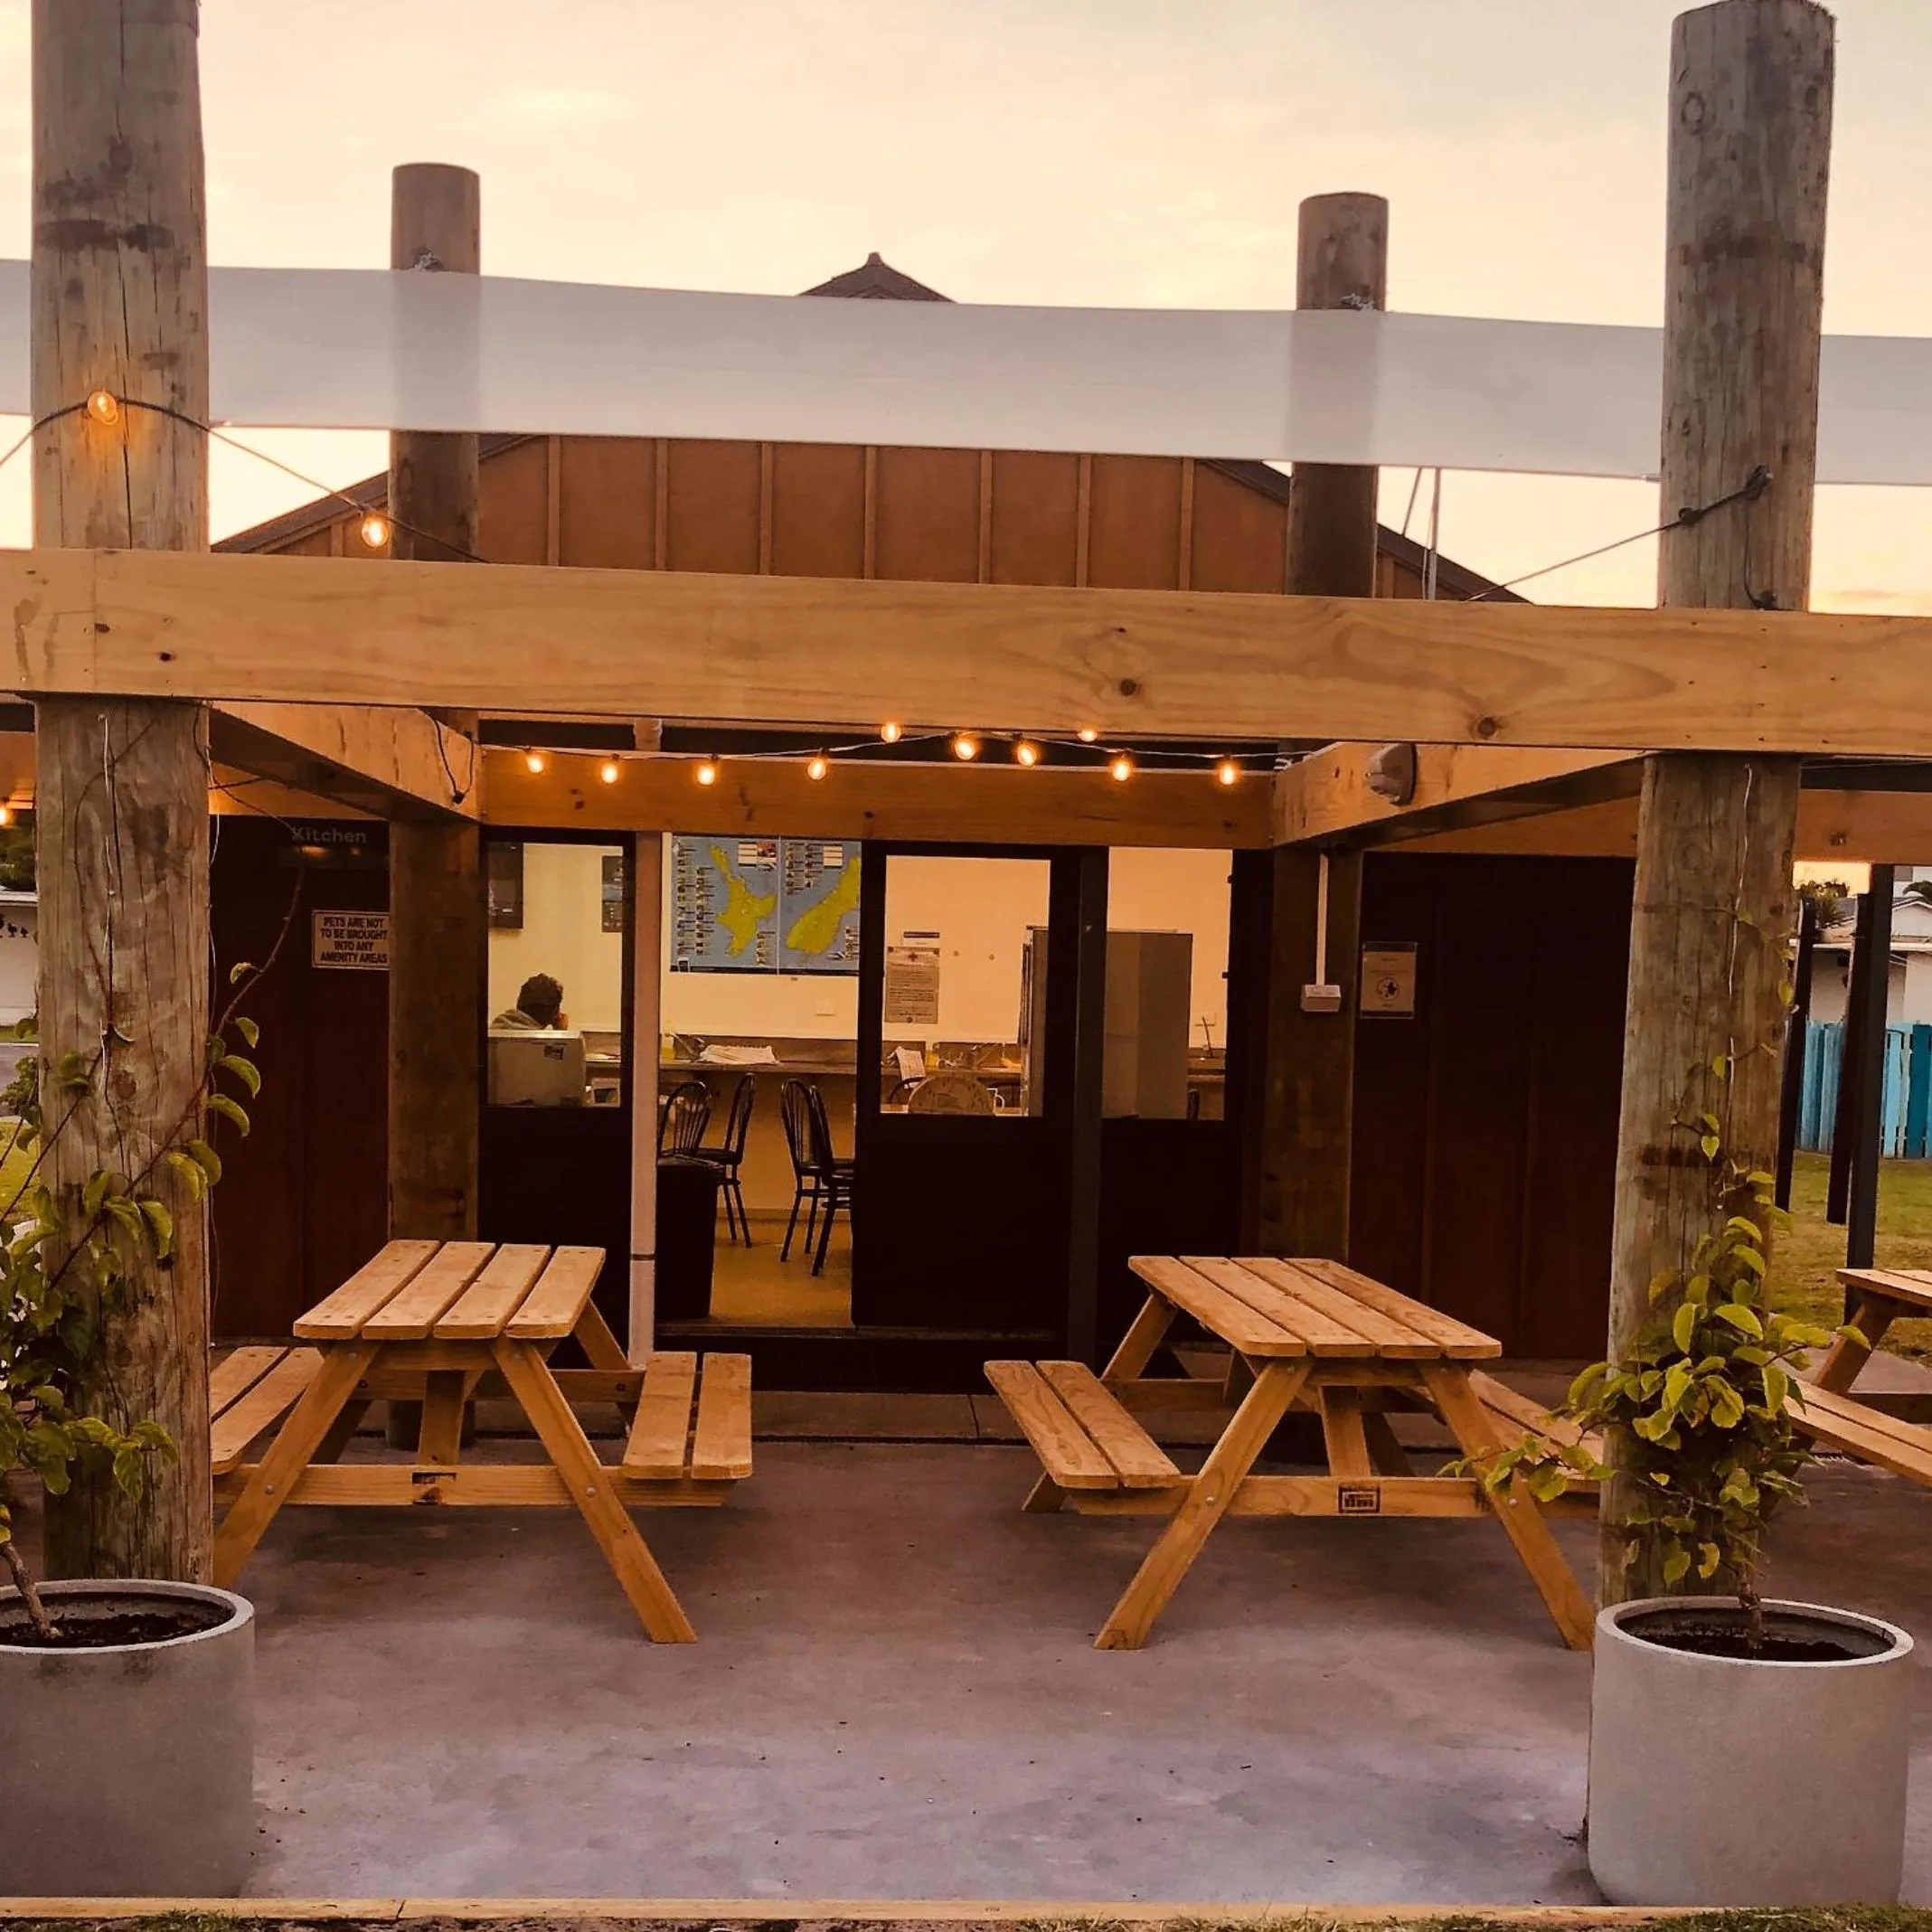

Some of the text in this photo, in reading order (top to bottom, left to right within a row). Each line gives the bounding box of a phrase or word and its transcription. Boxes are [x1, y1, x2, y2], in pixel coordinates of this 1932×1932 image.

[291, 826, 367, 843] Kitchen
[324, 917, 384, 928] PETS ARE NOT
[320, 928, 388, 939] TO BE BROUGHT
[335, 940, 373, 951] INTO ANY
[320, 952, 388, 963] AMENITY AREAS
